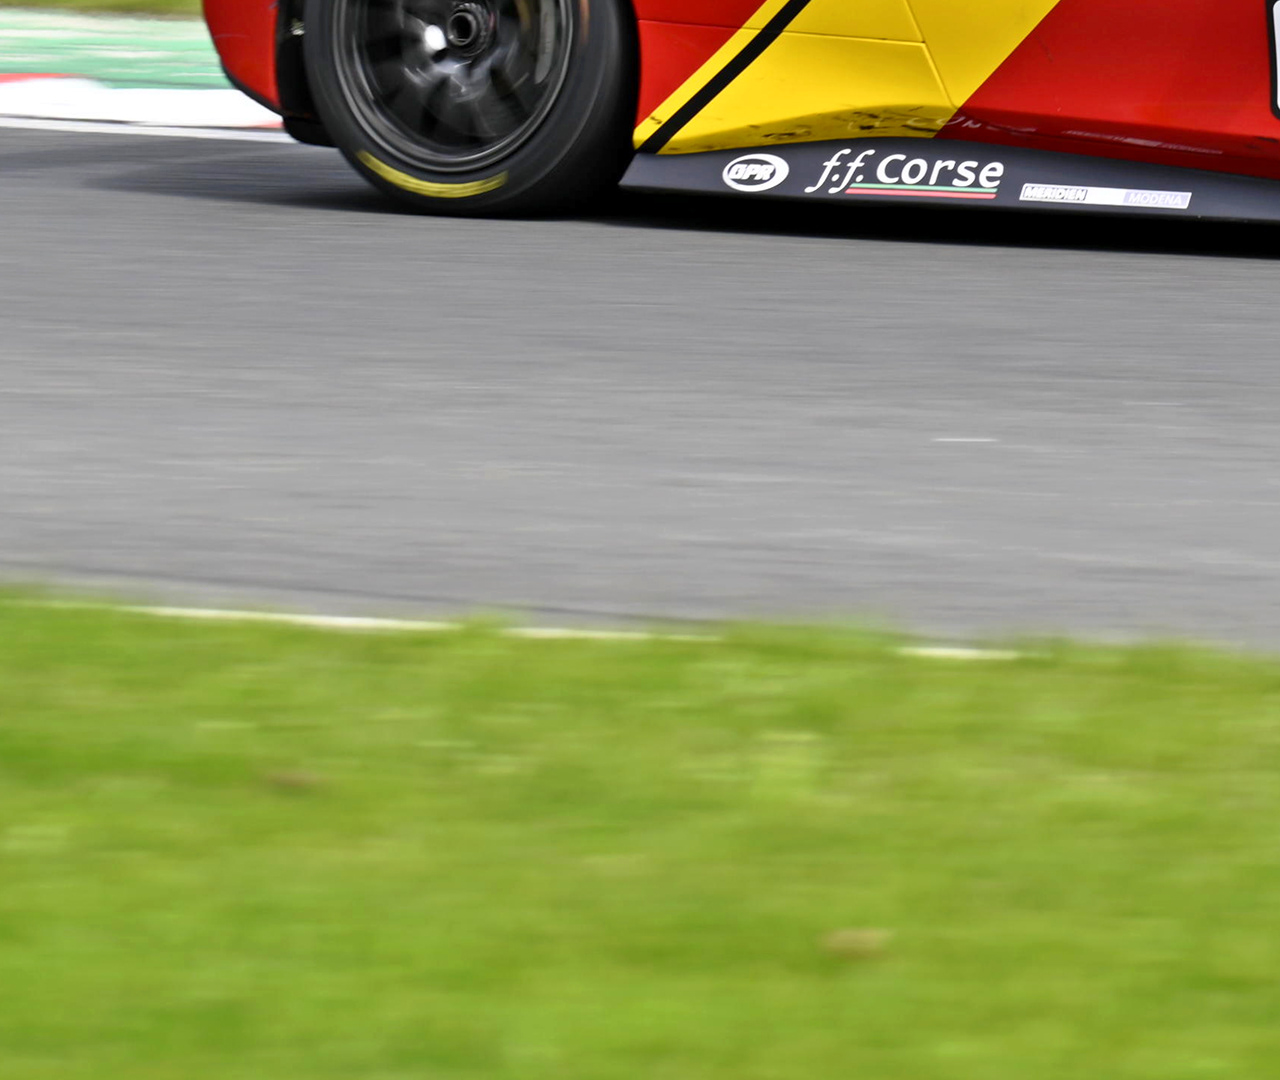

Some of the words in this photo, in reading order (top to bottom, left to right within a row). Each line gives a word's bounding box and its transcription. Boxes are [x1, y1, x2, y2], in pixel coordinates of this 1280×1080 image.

[876, 153, 1005, 189] Corse
[1023, 185, 1088, 202] MERIDIEN
[1127, 191, 1184, 207] MODENA
